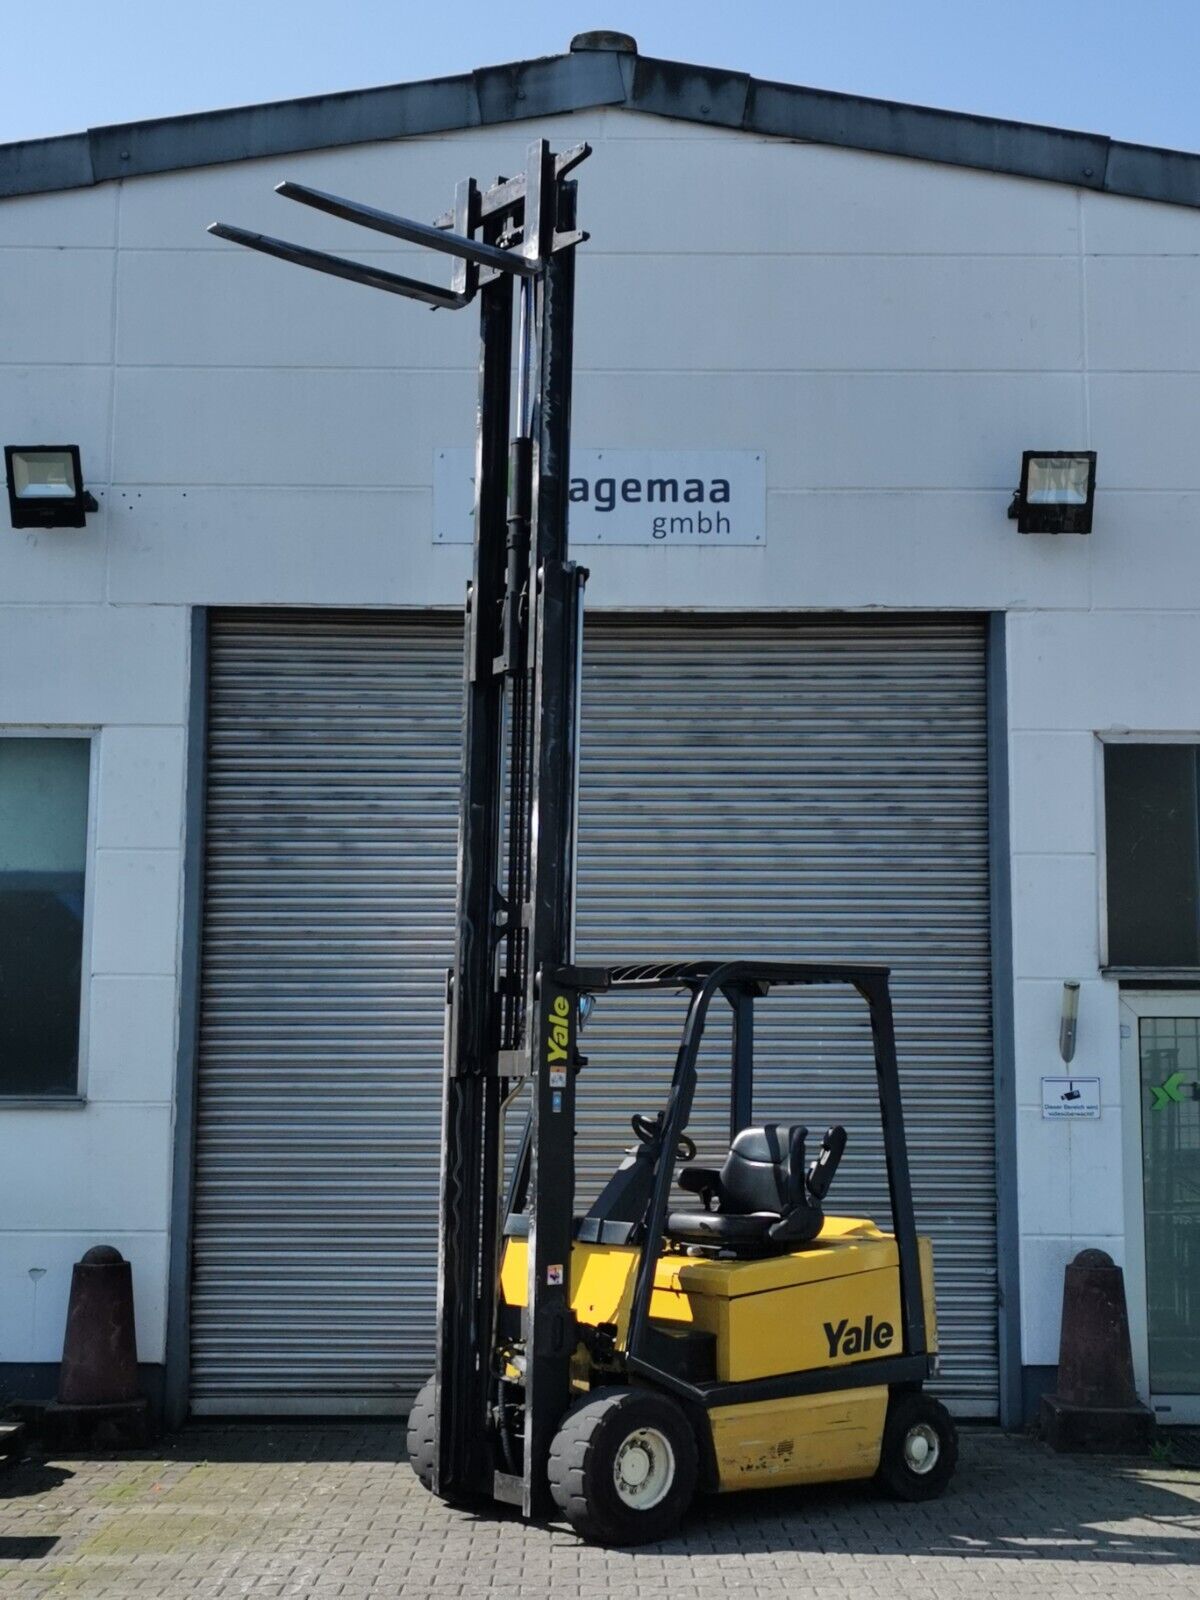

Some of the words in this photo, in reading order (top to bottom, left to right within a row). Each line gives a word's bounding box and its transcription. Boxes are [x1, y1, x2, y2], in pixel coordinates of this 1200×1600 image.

[569, 478, 730, 512] agemaa
[652, 511, 730, 539] gmbh
[547, 995, 570, 1063] Yale
[823, 1315, 894, 1358] Yale
